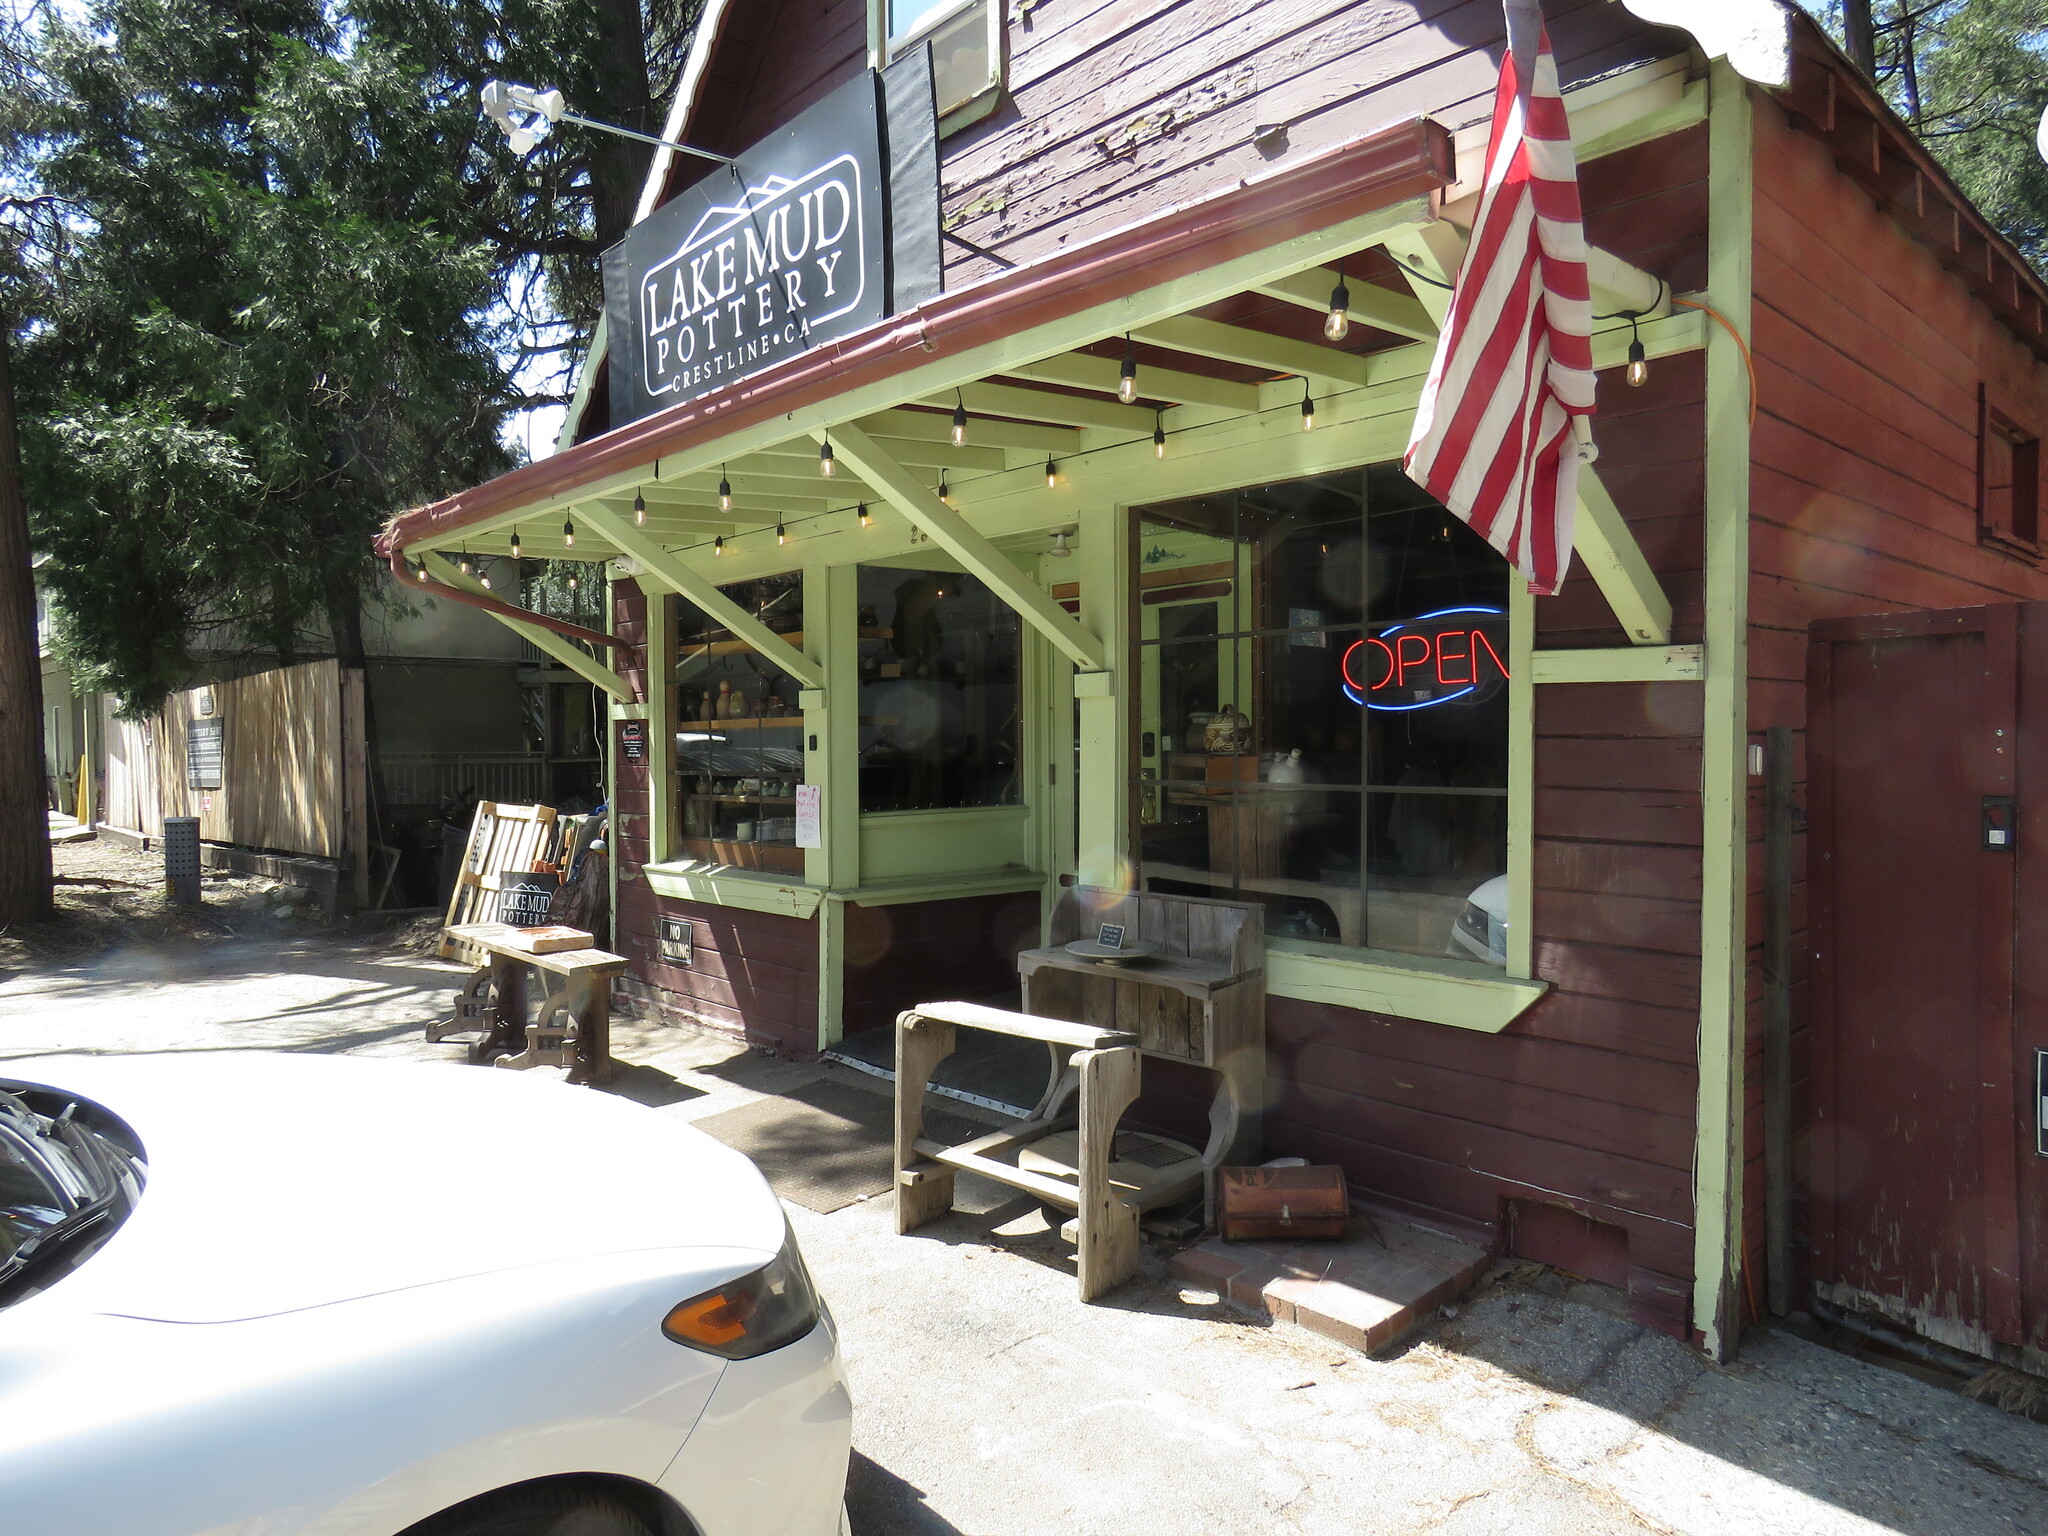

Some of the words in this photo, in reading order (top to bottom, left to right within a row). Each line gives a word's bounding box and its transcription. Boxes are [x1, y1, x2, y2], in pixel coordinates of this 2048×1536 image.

[647, 236, 737, 338] LAKE
[743, 179, 850, 286] MUD
[656, 250, 842, 375] POTTERY
[672, 336, 770, 393] CRESTLINE
[784, 317, 811, 344] CA
[1341, 630, 1511, 690] OPEN
[501, 910, 547, 925] POTTERY
[502, 892, 527, 911] LAKE
[527, 894, 550, 913] MUD
[661, 939, 690, 959] PARKING
[669, 924, 681, 941] NO
